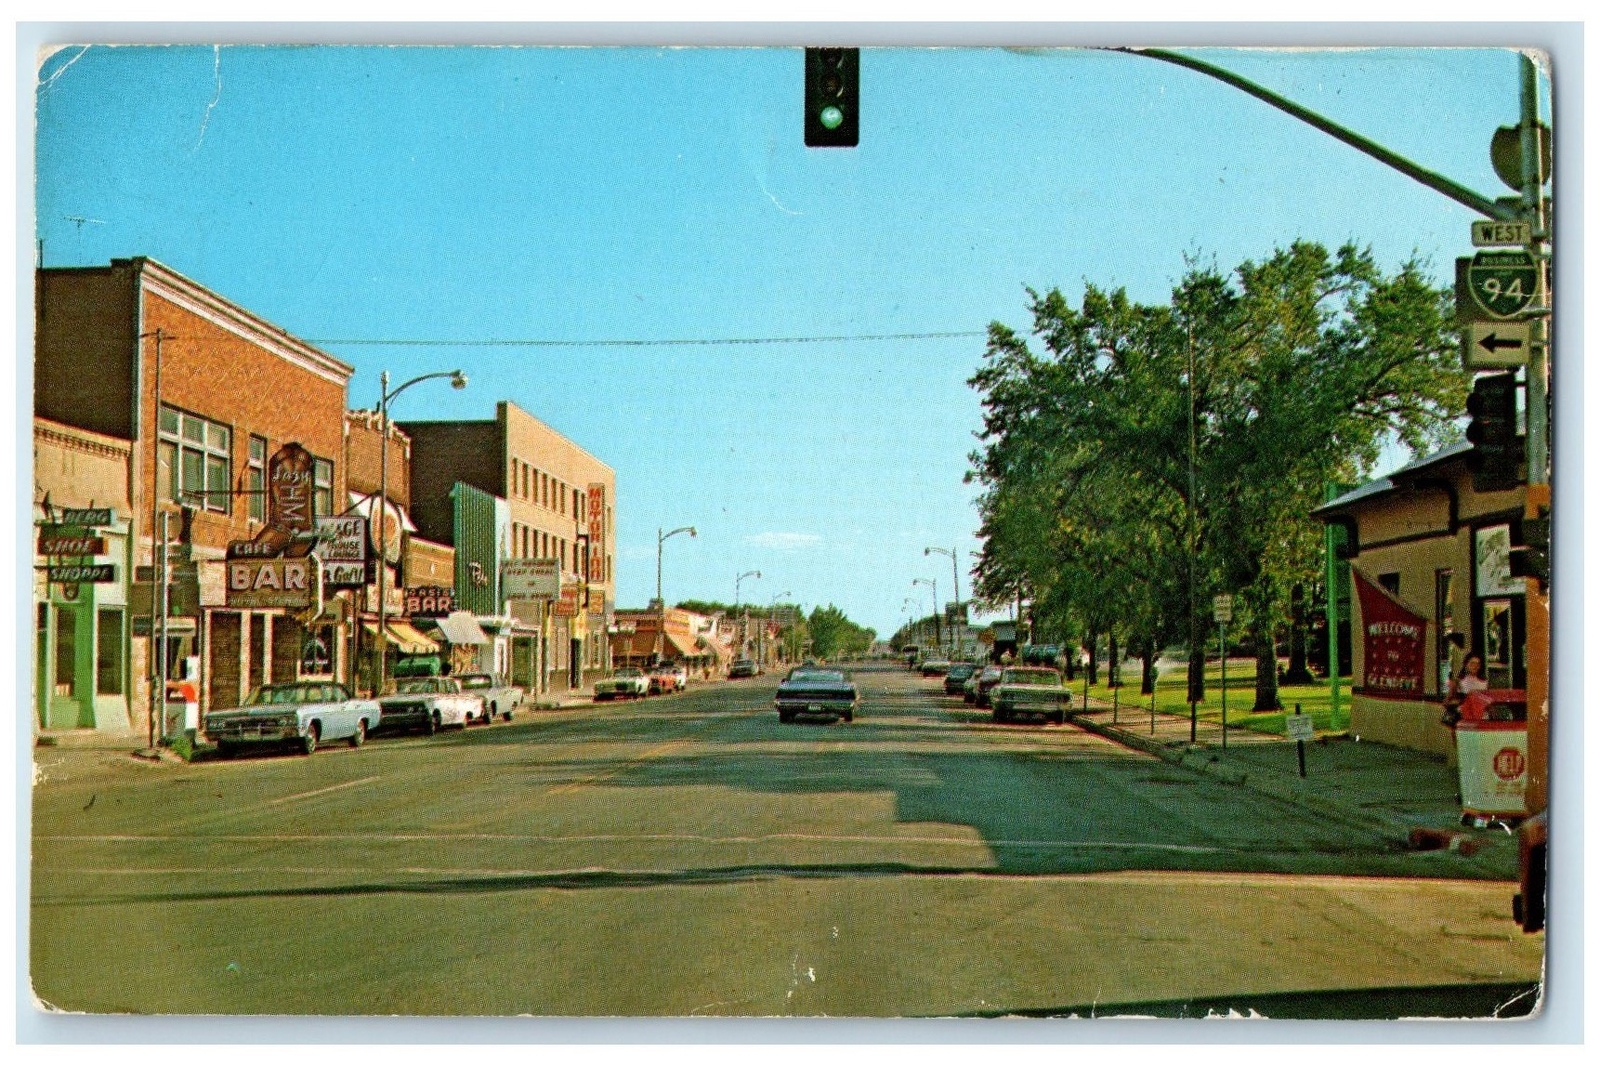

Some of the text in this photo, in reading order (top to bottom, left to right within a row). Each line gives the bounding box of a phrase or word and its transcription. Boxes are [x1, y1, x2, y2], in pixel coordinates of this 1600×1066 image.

[1481, 226, 1522, 240] WEST
[1483, 277, 1522, 304] 94
[589, 488, 602, 543] MOTOR
[44, 539, 92, 553] SHOE
[234, 542, 271, 555] CAFE
[50, 566, 110, 581] SHOPPE
[231, 563, 306, 590] BAR
[407, 596, 452, 612] BAR
[1367, 620, 1420, 639] WELCOME
[1387, 650, 1399, 662] TO
